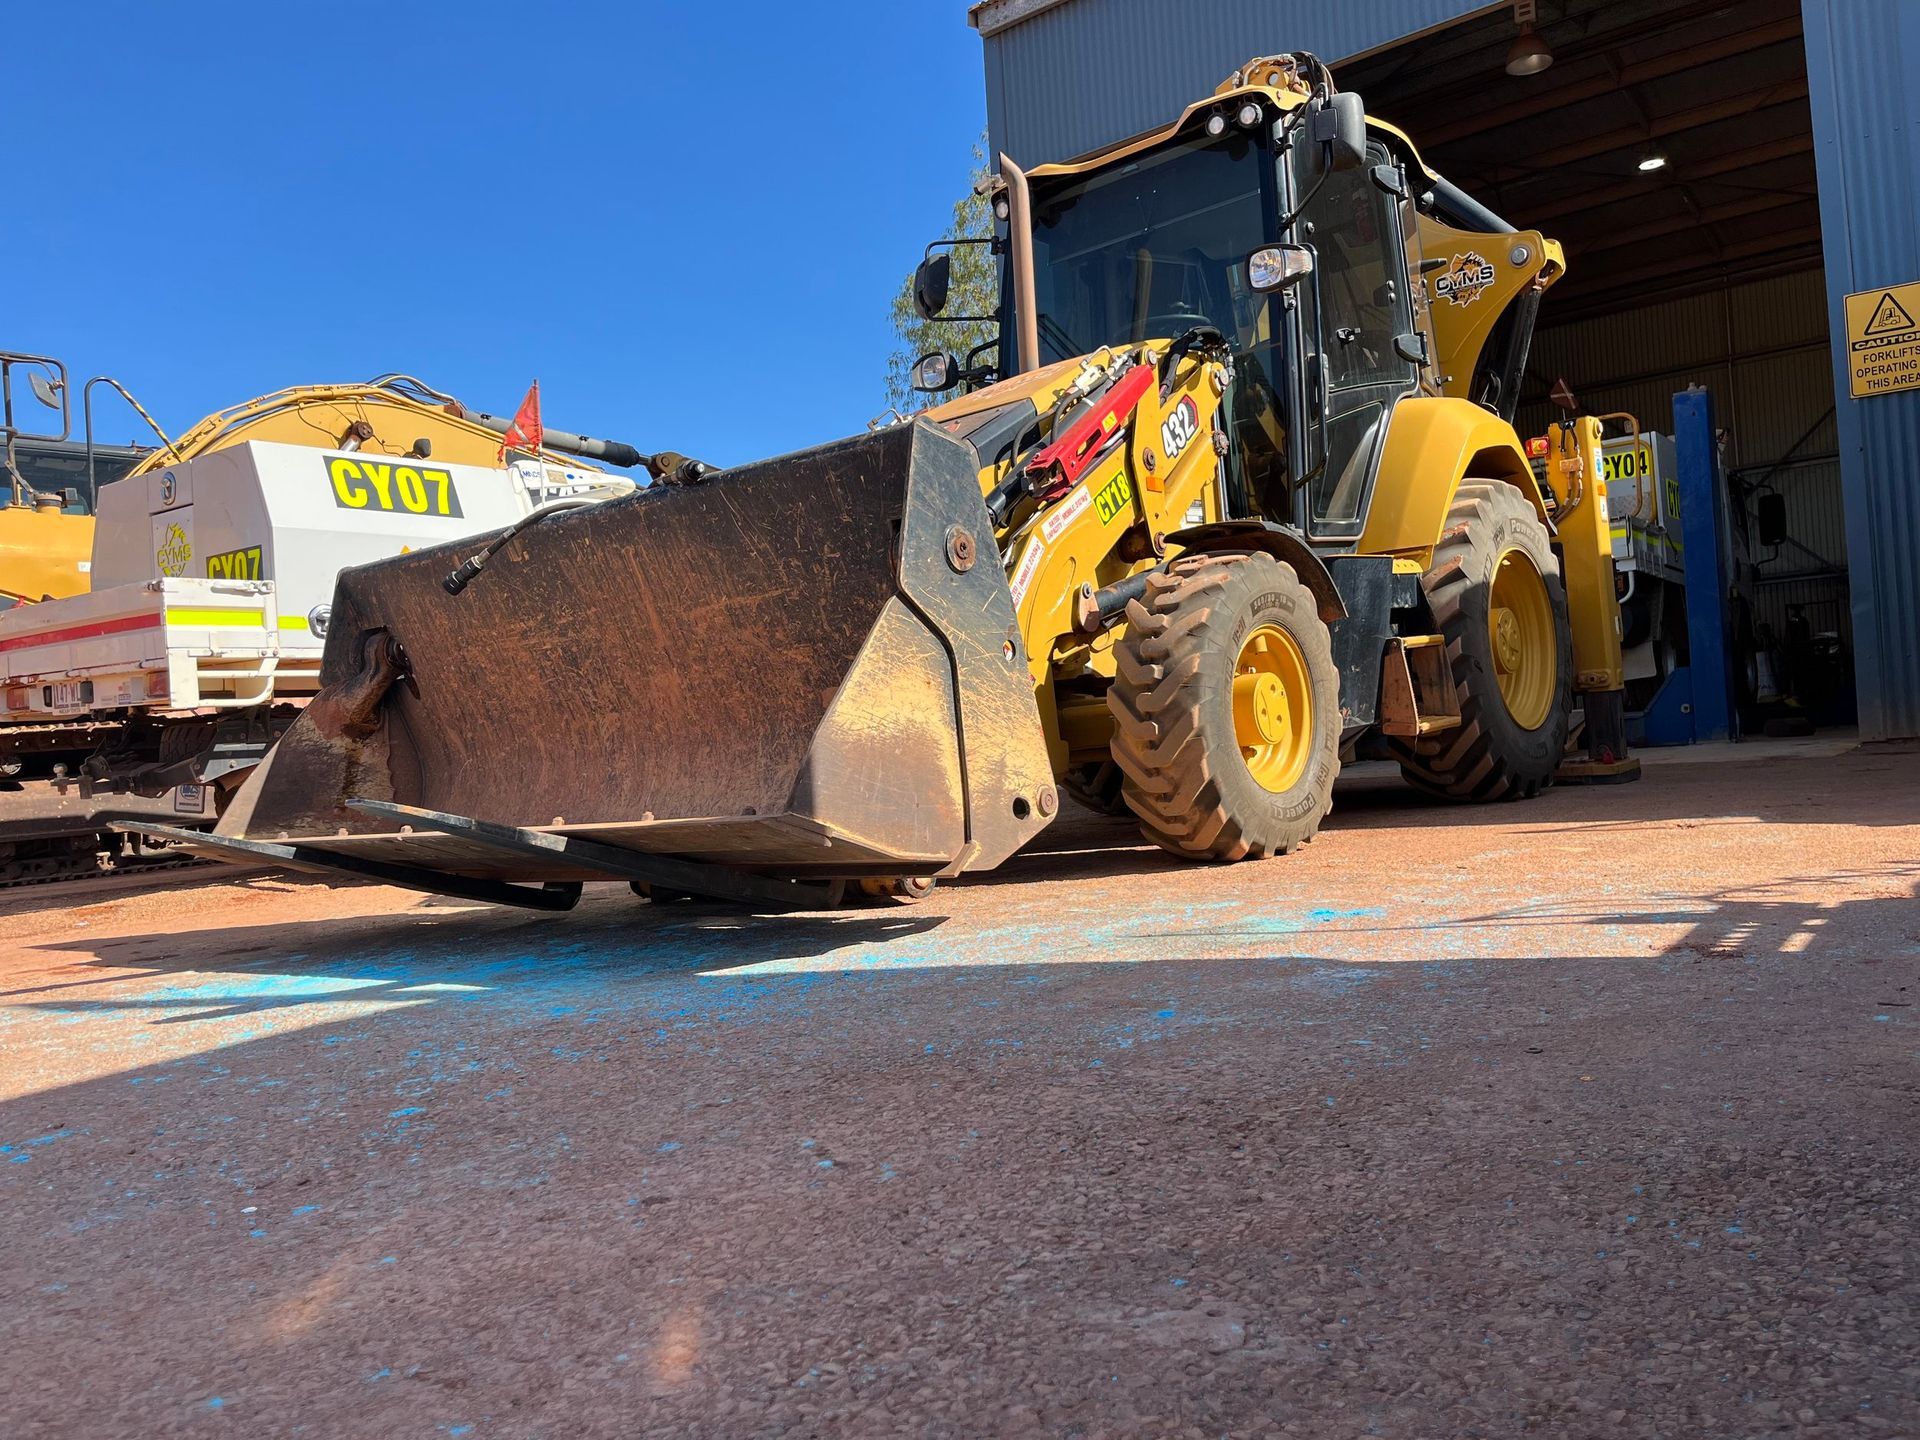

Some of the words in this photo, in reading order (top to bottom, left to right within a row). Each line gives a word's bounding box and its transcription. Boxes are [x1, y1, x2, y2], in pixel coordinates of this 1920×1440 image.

[1435, 264, 1494, 292] CYMS
[1856, 359, 1918, 378] OPERATING
[1863, 345, 1920, 364] FORKLIFTS
[1866, 377, 1890, 390] THIS
[1892, 372, 1920, 386] AREA
[1161, 402, 1196, 458] 432
[1602, 451, 1648, 481] CY04
[330, 458, 450, 515] CY07
[1095, 474, 1131, 522] CY18
[157, 543, 192, 568] CYMS
